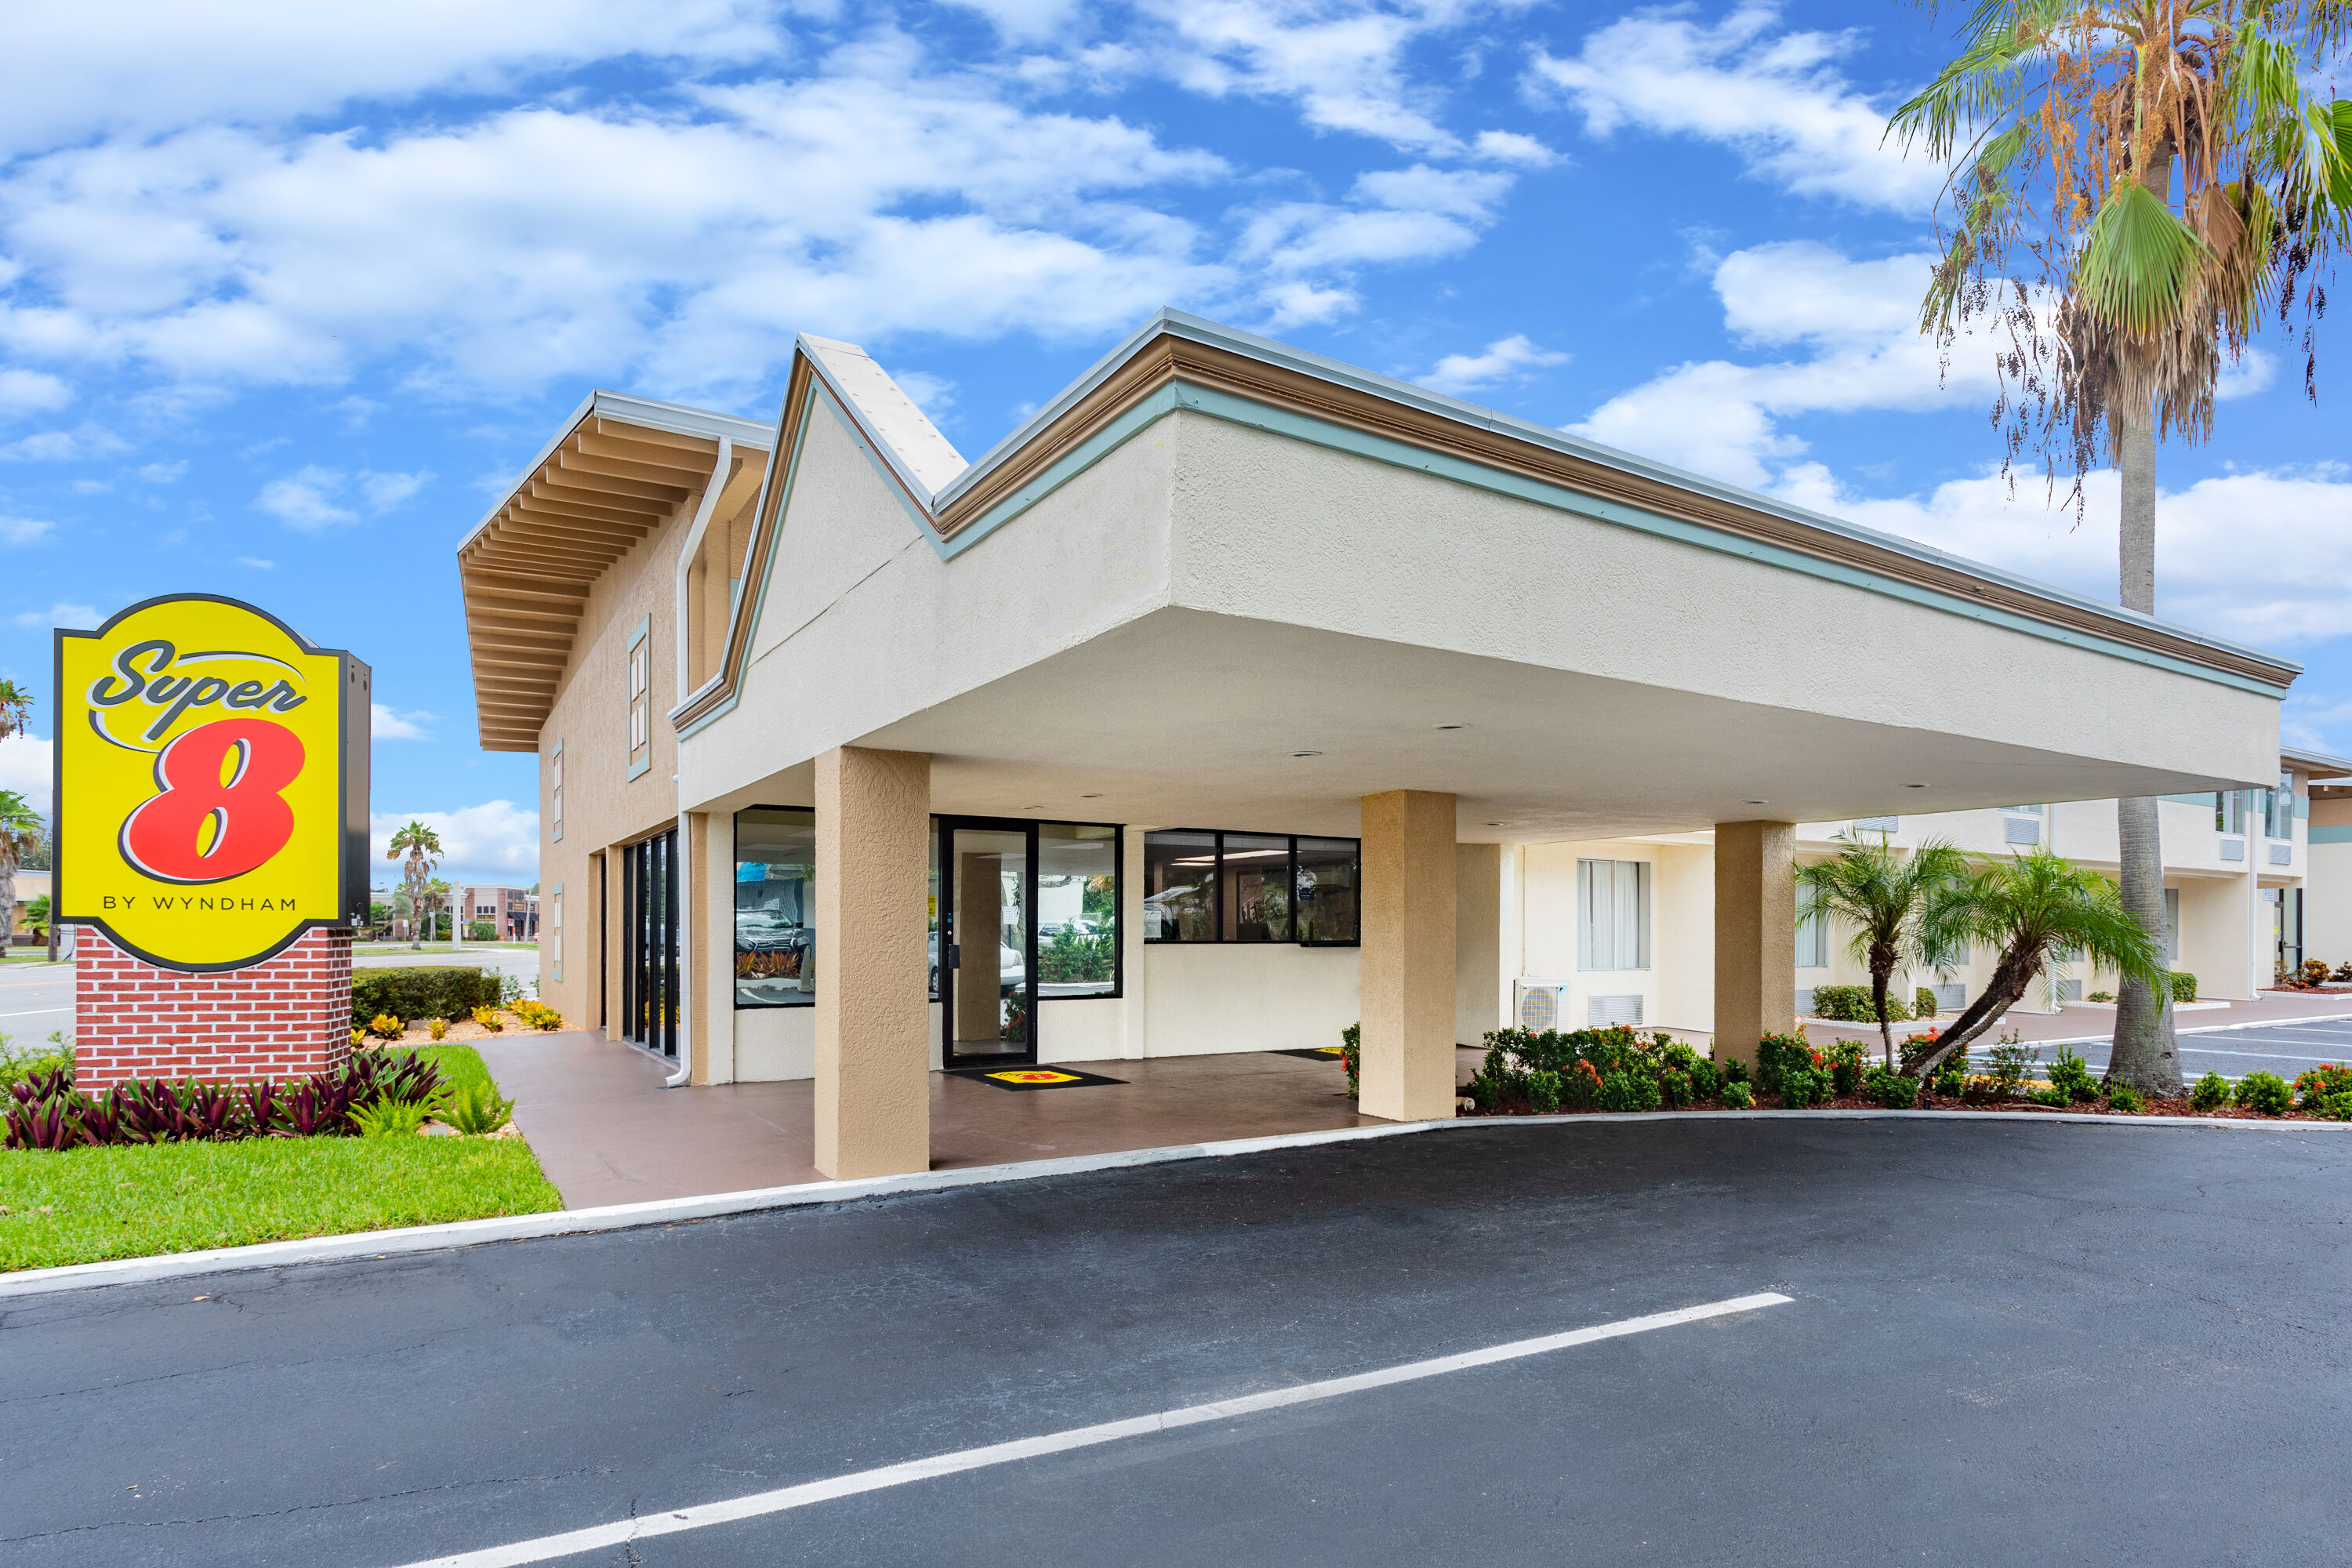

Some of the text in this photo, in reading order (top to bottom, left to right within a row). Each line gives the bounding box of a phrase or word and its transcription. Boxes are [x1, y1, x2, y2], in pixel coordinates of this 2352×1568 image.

[85, 639, 307, 742] Super
[117, 717, 305, 885] 8
[103, 896, 296, 911] BY WYNDHAM
